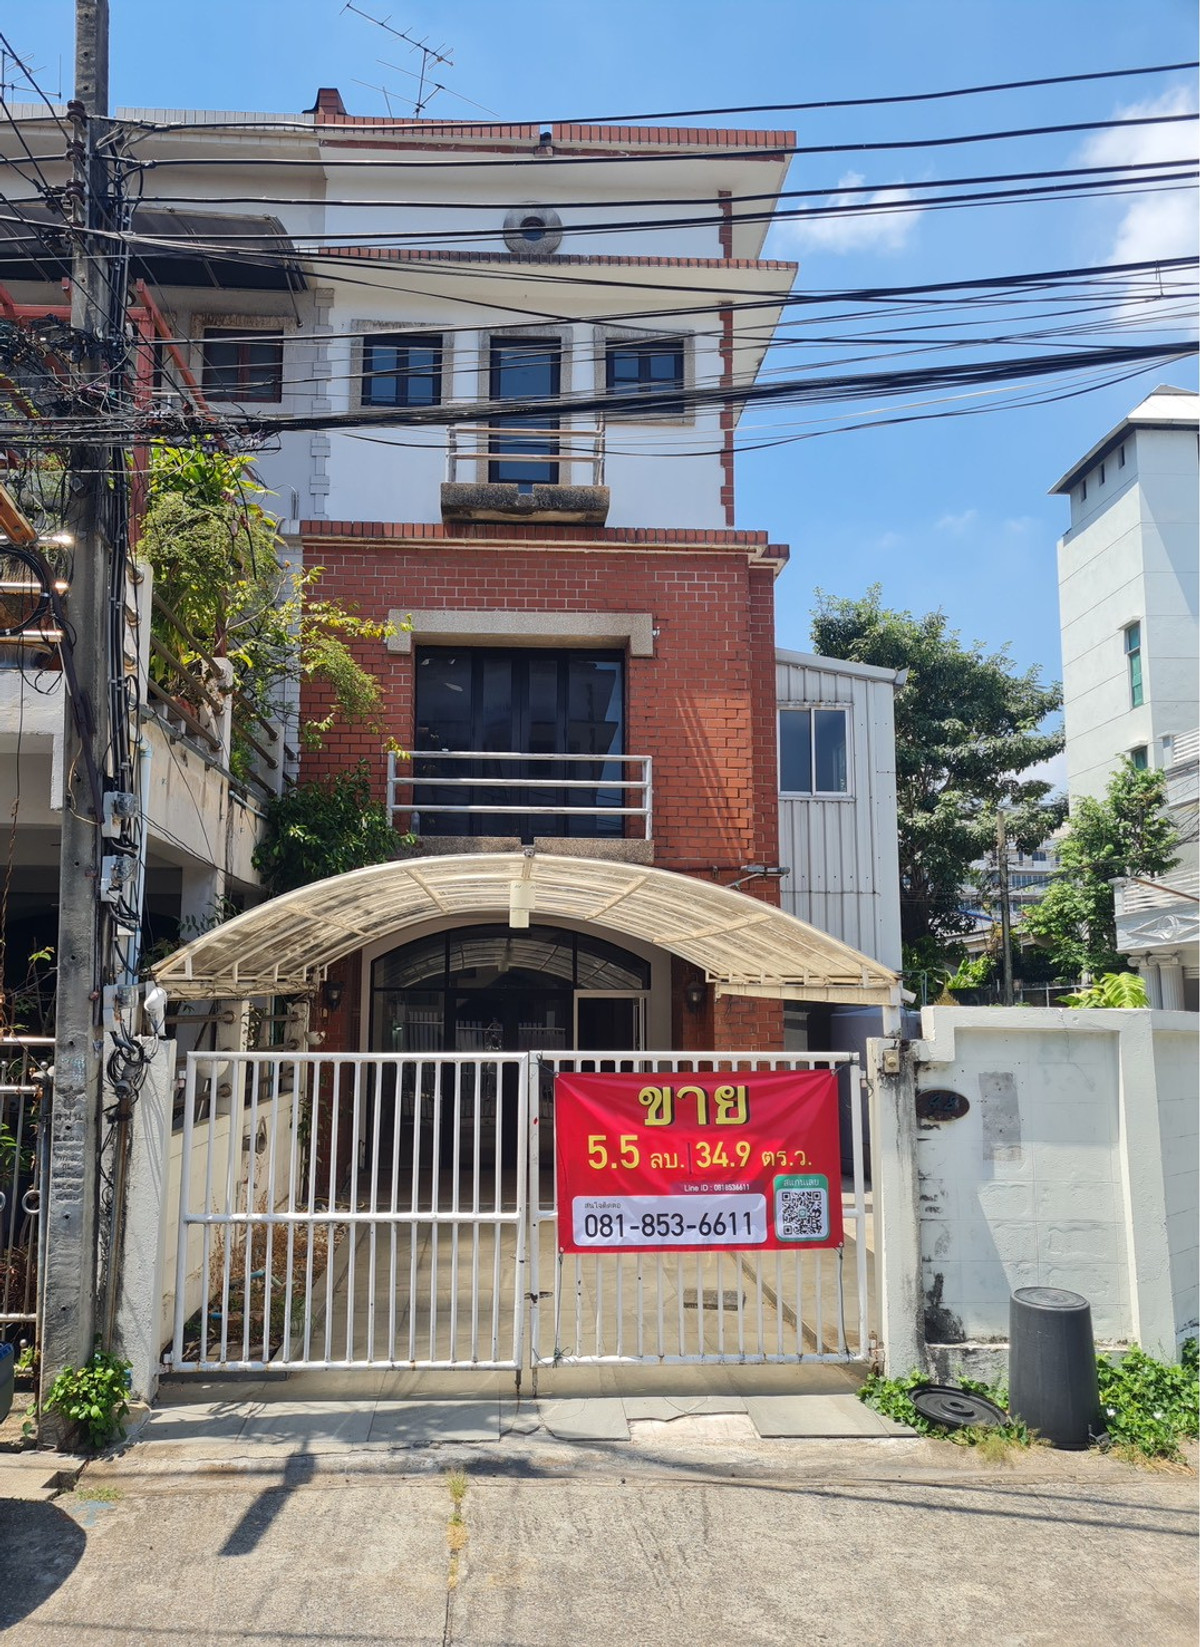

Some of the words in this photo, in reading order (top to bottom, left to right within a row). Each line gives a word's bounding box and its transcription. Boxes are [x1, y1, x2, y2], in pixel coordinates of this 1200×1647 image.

[638, 1085, 749, 1127] ขาย
[588, 1134, 640, 1169] 5.5
[650, 1152, 686, 1169] ลบ.
[695, 1141, 751, 1168] 34.9
[761, 1149, 812, 1168] ตร.ว.
[684, 1184, 699, 1192] Line
[713, 1183, 750, 1192] 0818536611
[584, 1211, 752, 1238] 081-853-6611
